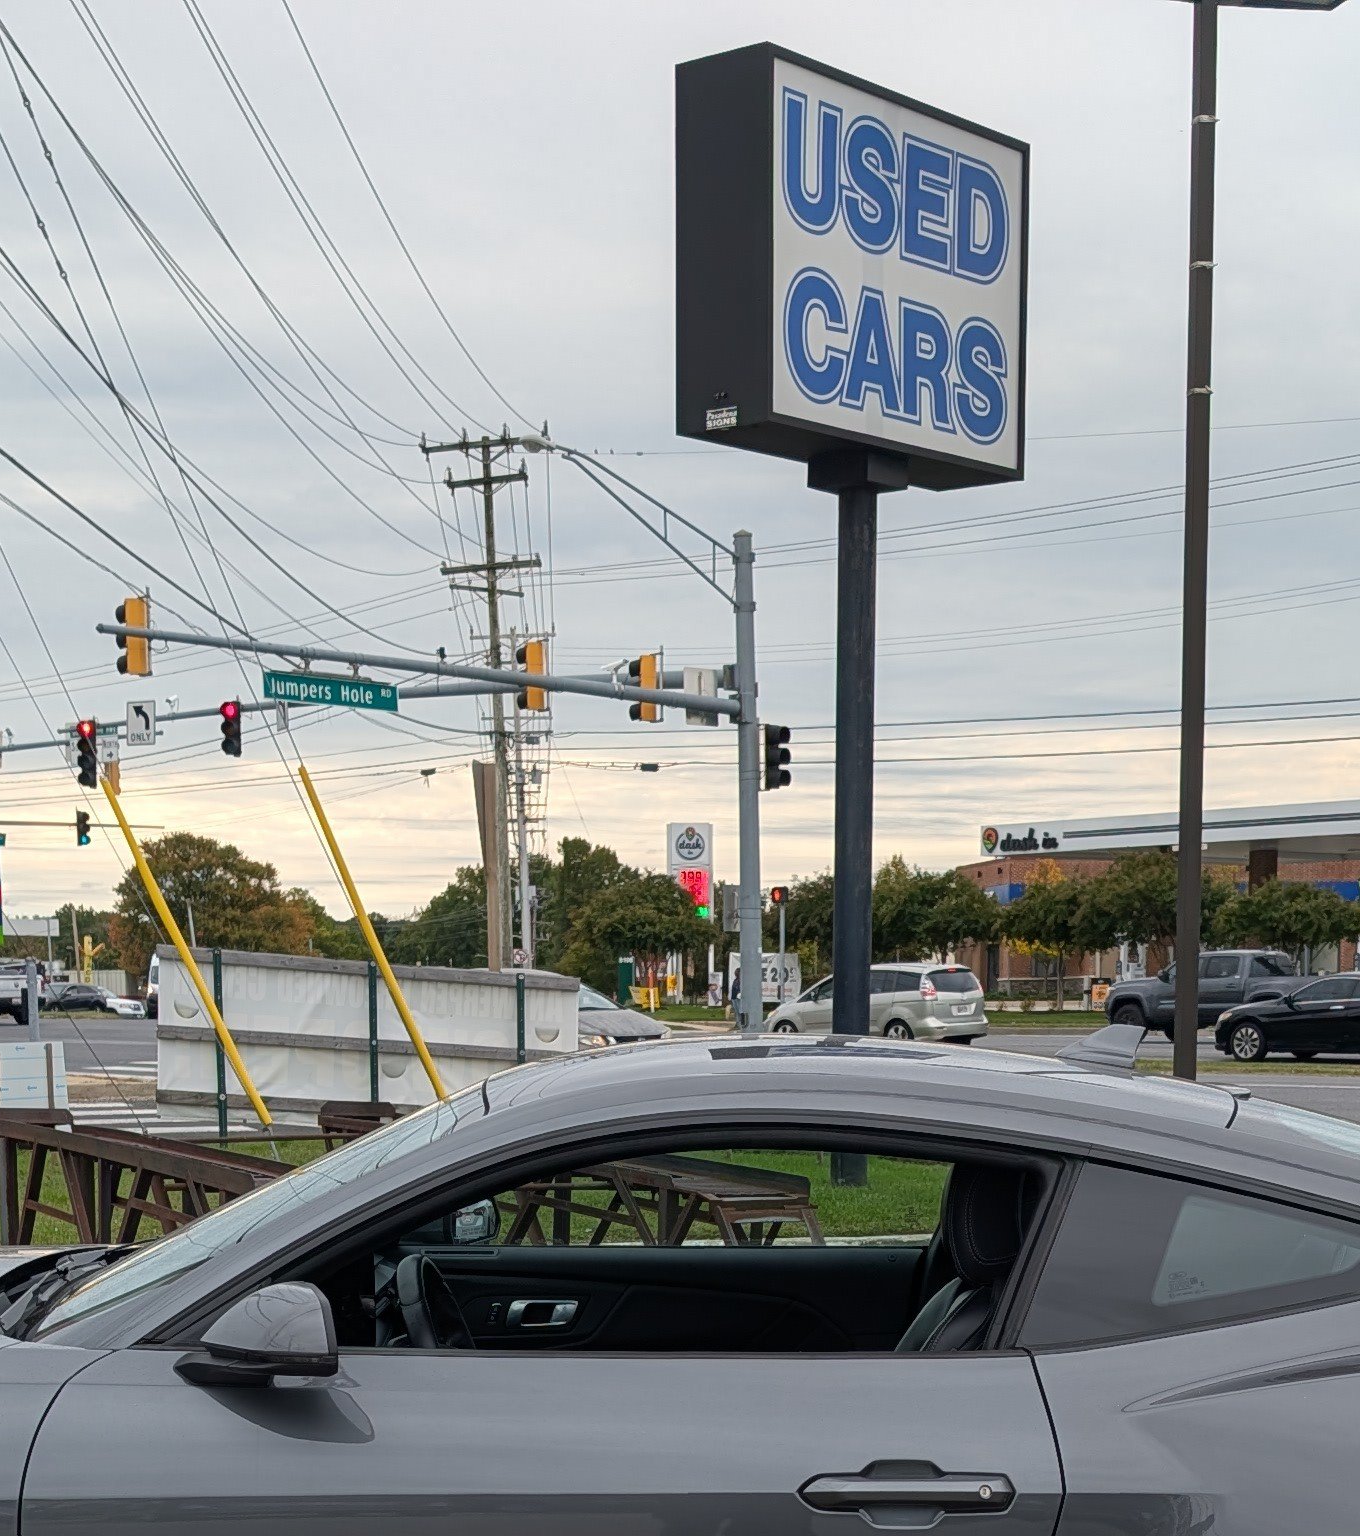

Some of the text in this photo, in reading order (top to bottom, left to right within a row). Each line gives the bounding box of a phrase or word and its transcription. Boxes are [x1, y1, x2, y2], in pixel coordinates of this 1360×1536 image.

[782, 86, 1009, 285] USED
[783, 267, 1007, 445] CARS
[706, 417, 737, 428] SIGNS
[271, 677, 392, 705] Jumpers Hole RD
[130, 732, 152, 742] ONLY
[679, 838, 702, 850] dash
[1000, 827, 1059, 852] dash in
